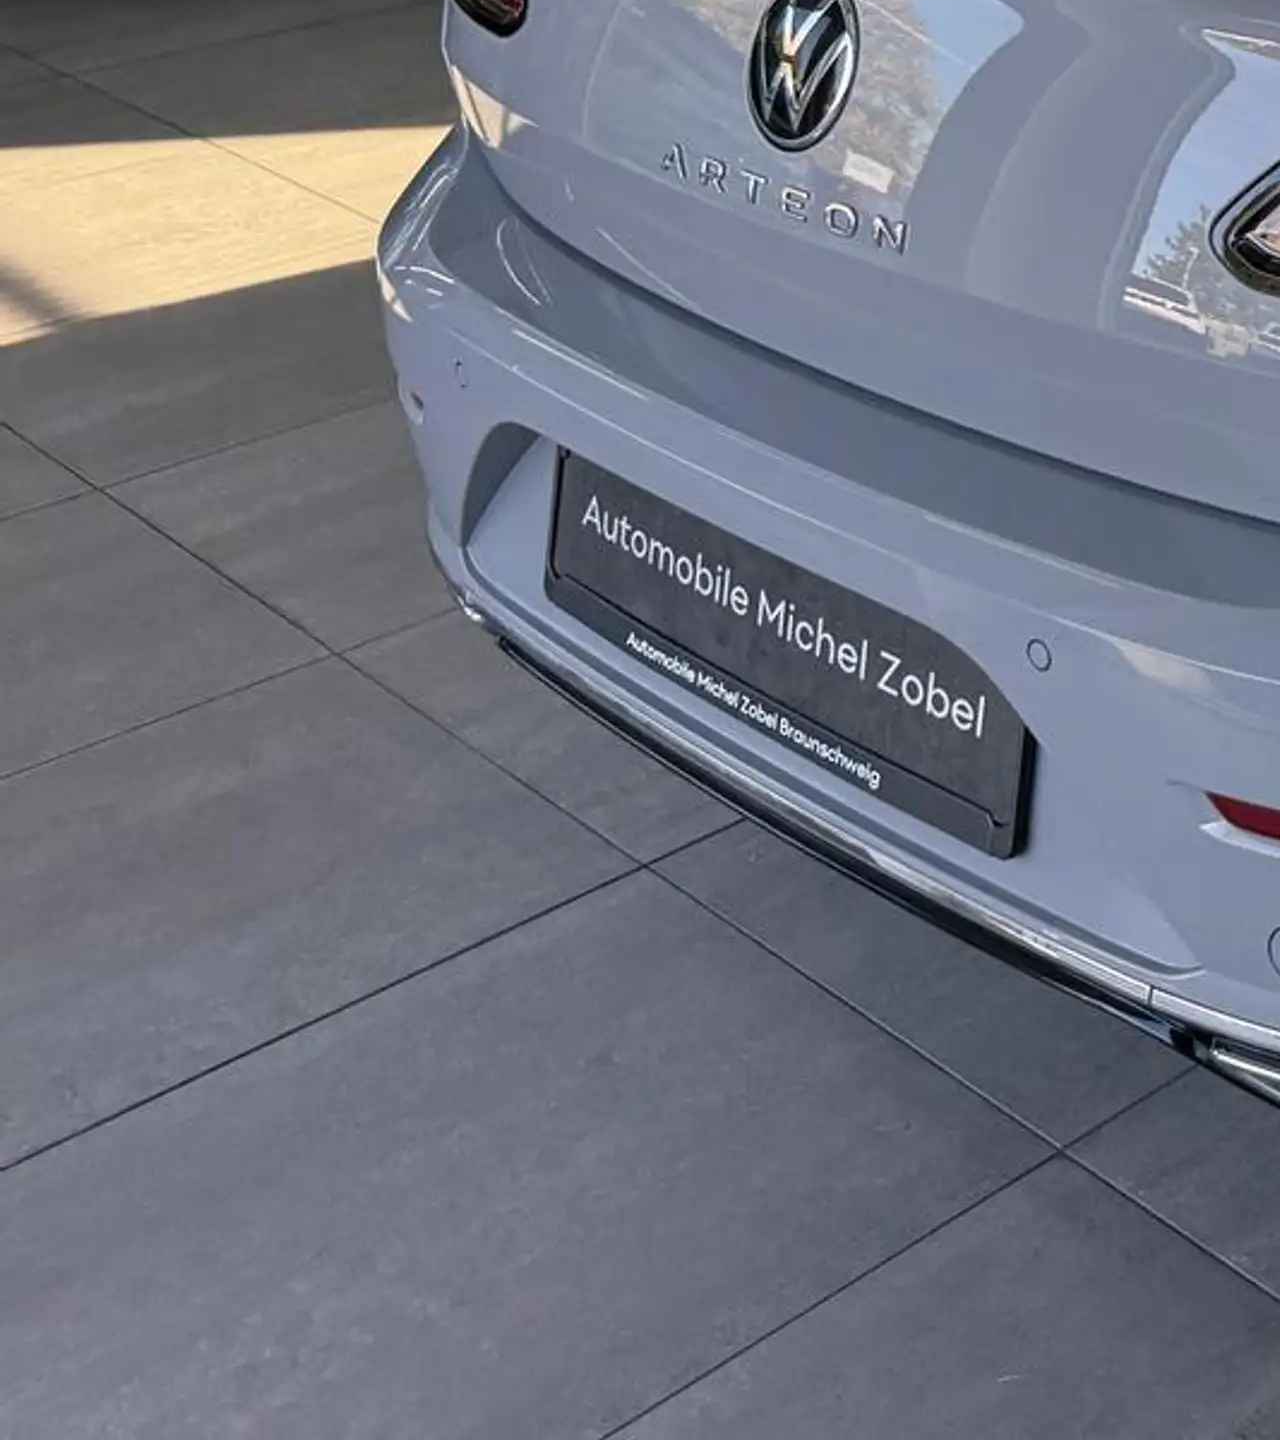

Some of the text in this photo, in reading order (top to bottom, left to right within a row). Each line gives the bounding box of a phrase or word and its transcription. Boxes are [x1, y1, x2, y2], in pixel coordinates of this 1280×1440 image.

[661, 142, 911, 256] ARTEON
[581, 494, 985, 739] Automobile Michel Zobel
[626, 631, 882, 791] Automobile Michel Zobel Braunschweig
